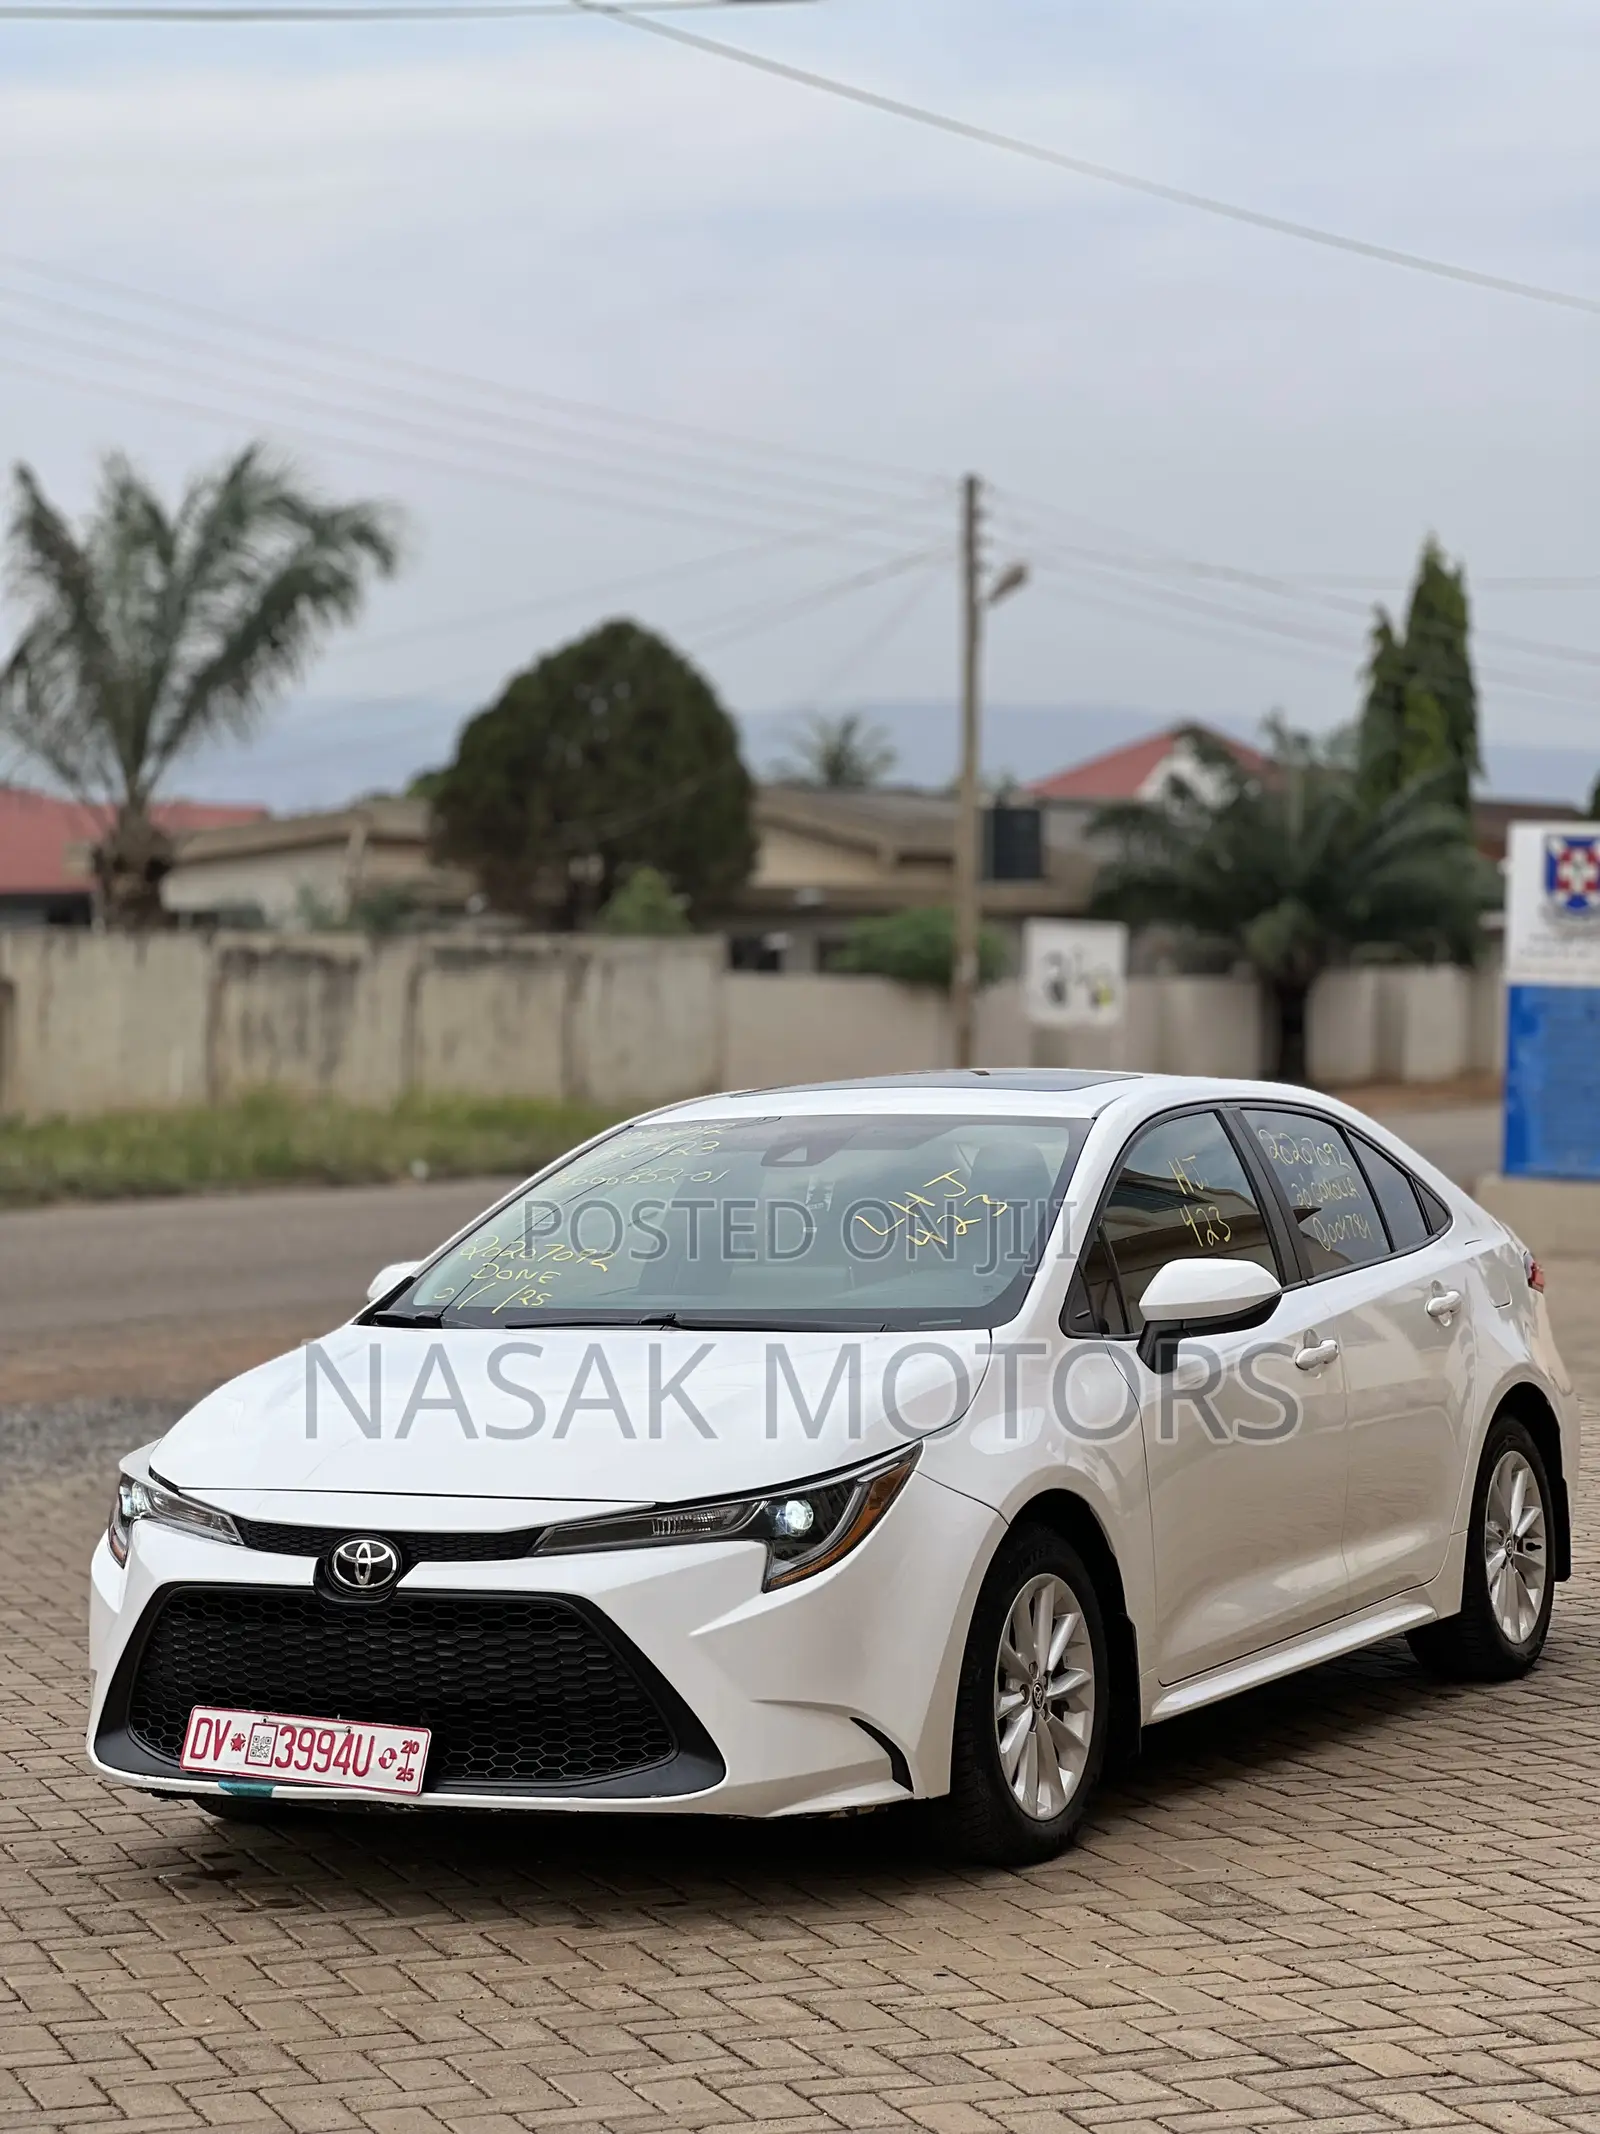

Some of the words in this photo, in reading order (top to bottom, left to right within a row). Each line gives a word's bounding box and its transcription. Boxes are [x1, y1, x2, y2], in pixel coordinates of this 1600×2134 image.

[1180, 1204, 1231, 1248] 423
[471, 1262, 562, 1285] DONE
[190, 1717, 232, 1761] DV
[274, 1724, 375, 1777] 3994U
